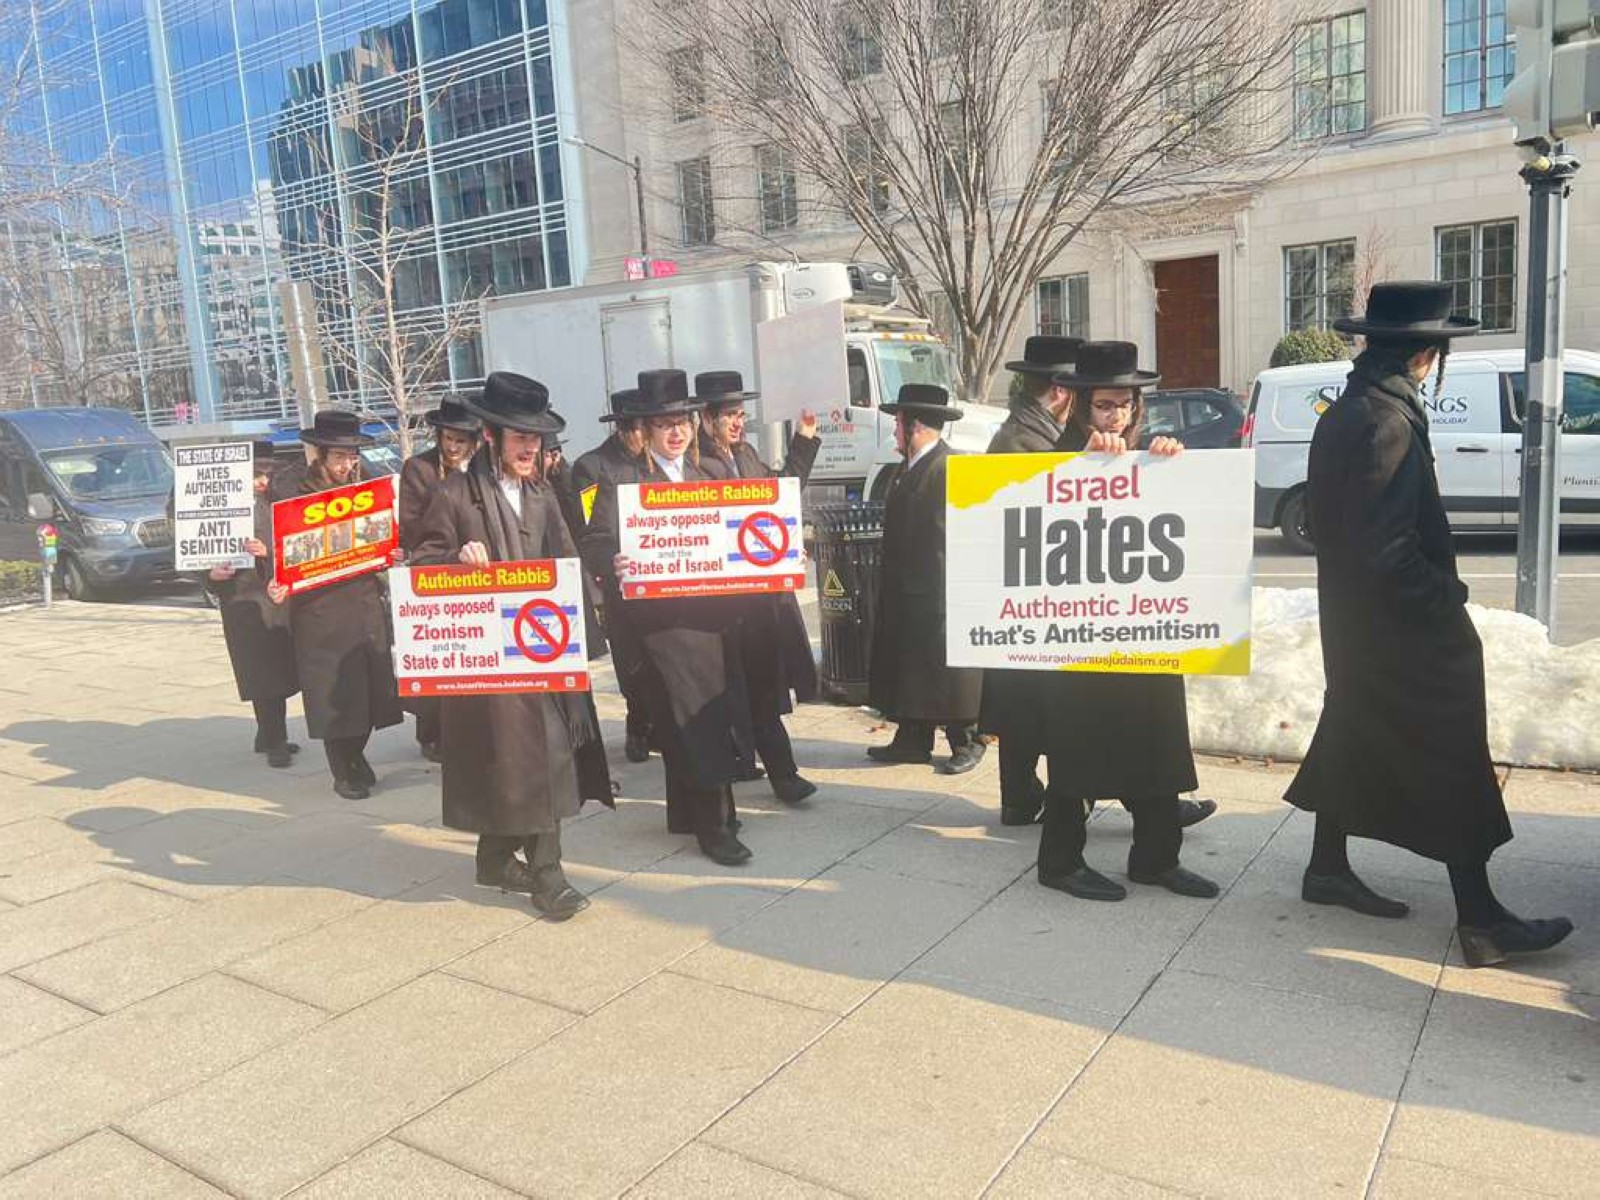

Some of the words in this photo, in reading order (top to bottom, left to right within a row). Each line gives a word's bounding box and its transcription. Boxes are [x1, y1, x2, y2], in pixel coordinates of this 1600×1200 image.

[178, 450, 191, 464] THE
[193, 448, 213, 463] STATE
[214, 448, 223, 461] OF
[224, 446, 248, 461] ISRAEL
[197, 466, 230, 480] HATES
[185, 479, 243, 496] AUTHENTIC
[1047, 464, 1140, 504] Israel
[199, 494, 228, 508] JEWS
[646, 486, 718, 504] Authentic
[723, 484, 774, 501] Rabbis
[303, 491, 374, 525] SOS
[199, 521, 231, 537] ANTI
[626, 513, 667, 530] always
[671, 511, 720, 529] opposed
[639, 533, 710, 550] Zionism
[1004, 506, 1186, 587] Hates
[658, 550, 675, 558] and
[677, 549, 692, 558] the
[629, 560, 663, 576] State
[668, 559, 681, 574] of
[685, 557, 723, 573] Israel
[417, 568, 492, 590] Authentic
[496, 567, 551, 585] Rabbis
[399, 600, 440, 619] always
[444, 597, 495, 618] opposed
[999, 593, 1119, 620] Authentic
[1127, 594, 1189, 617] Jews
[413, 623, 485, 641] Zionism
[969, 625, 1036, 646] that's
[1044, 619, 1220, 645] Anti-semitism
[432, 642, 450, 652] and
[452, 641, 467, 651] the
[403, 654, 439, 670] State
[443, 652, 456, 668] of
[461, 651, 499, 668] Israel
[1007, 651, 1180, 669] www.israelversusjudaism.org
